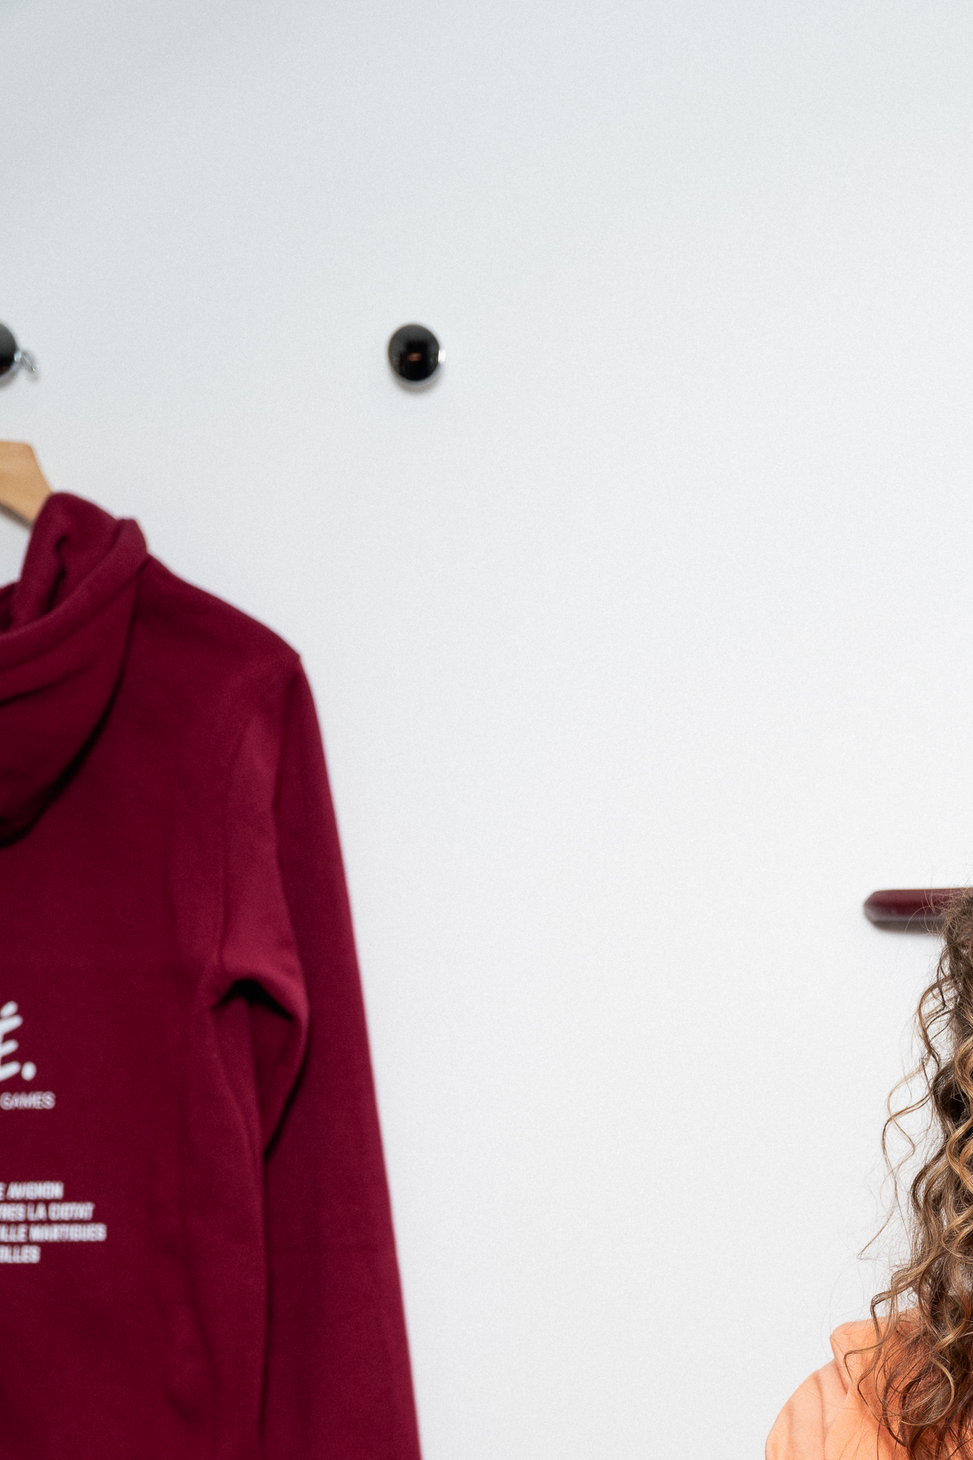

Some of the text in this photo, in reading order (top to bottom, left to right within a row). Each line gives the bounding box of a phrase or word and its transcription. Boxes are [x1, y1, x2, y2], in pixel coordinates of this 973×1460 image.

[0, 1091, 56, 1110] GAMES
[6, 1180, 65, 1200] AVIGNON
[27, 1201, 47, 1222] LA
[29, 1222, 107, 1242] MARTIGUES
